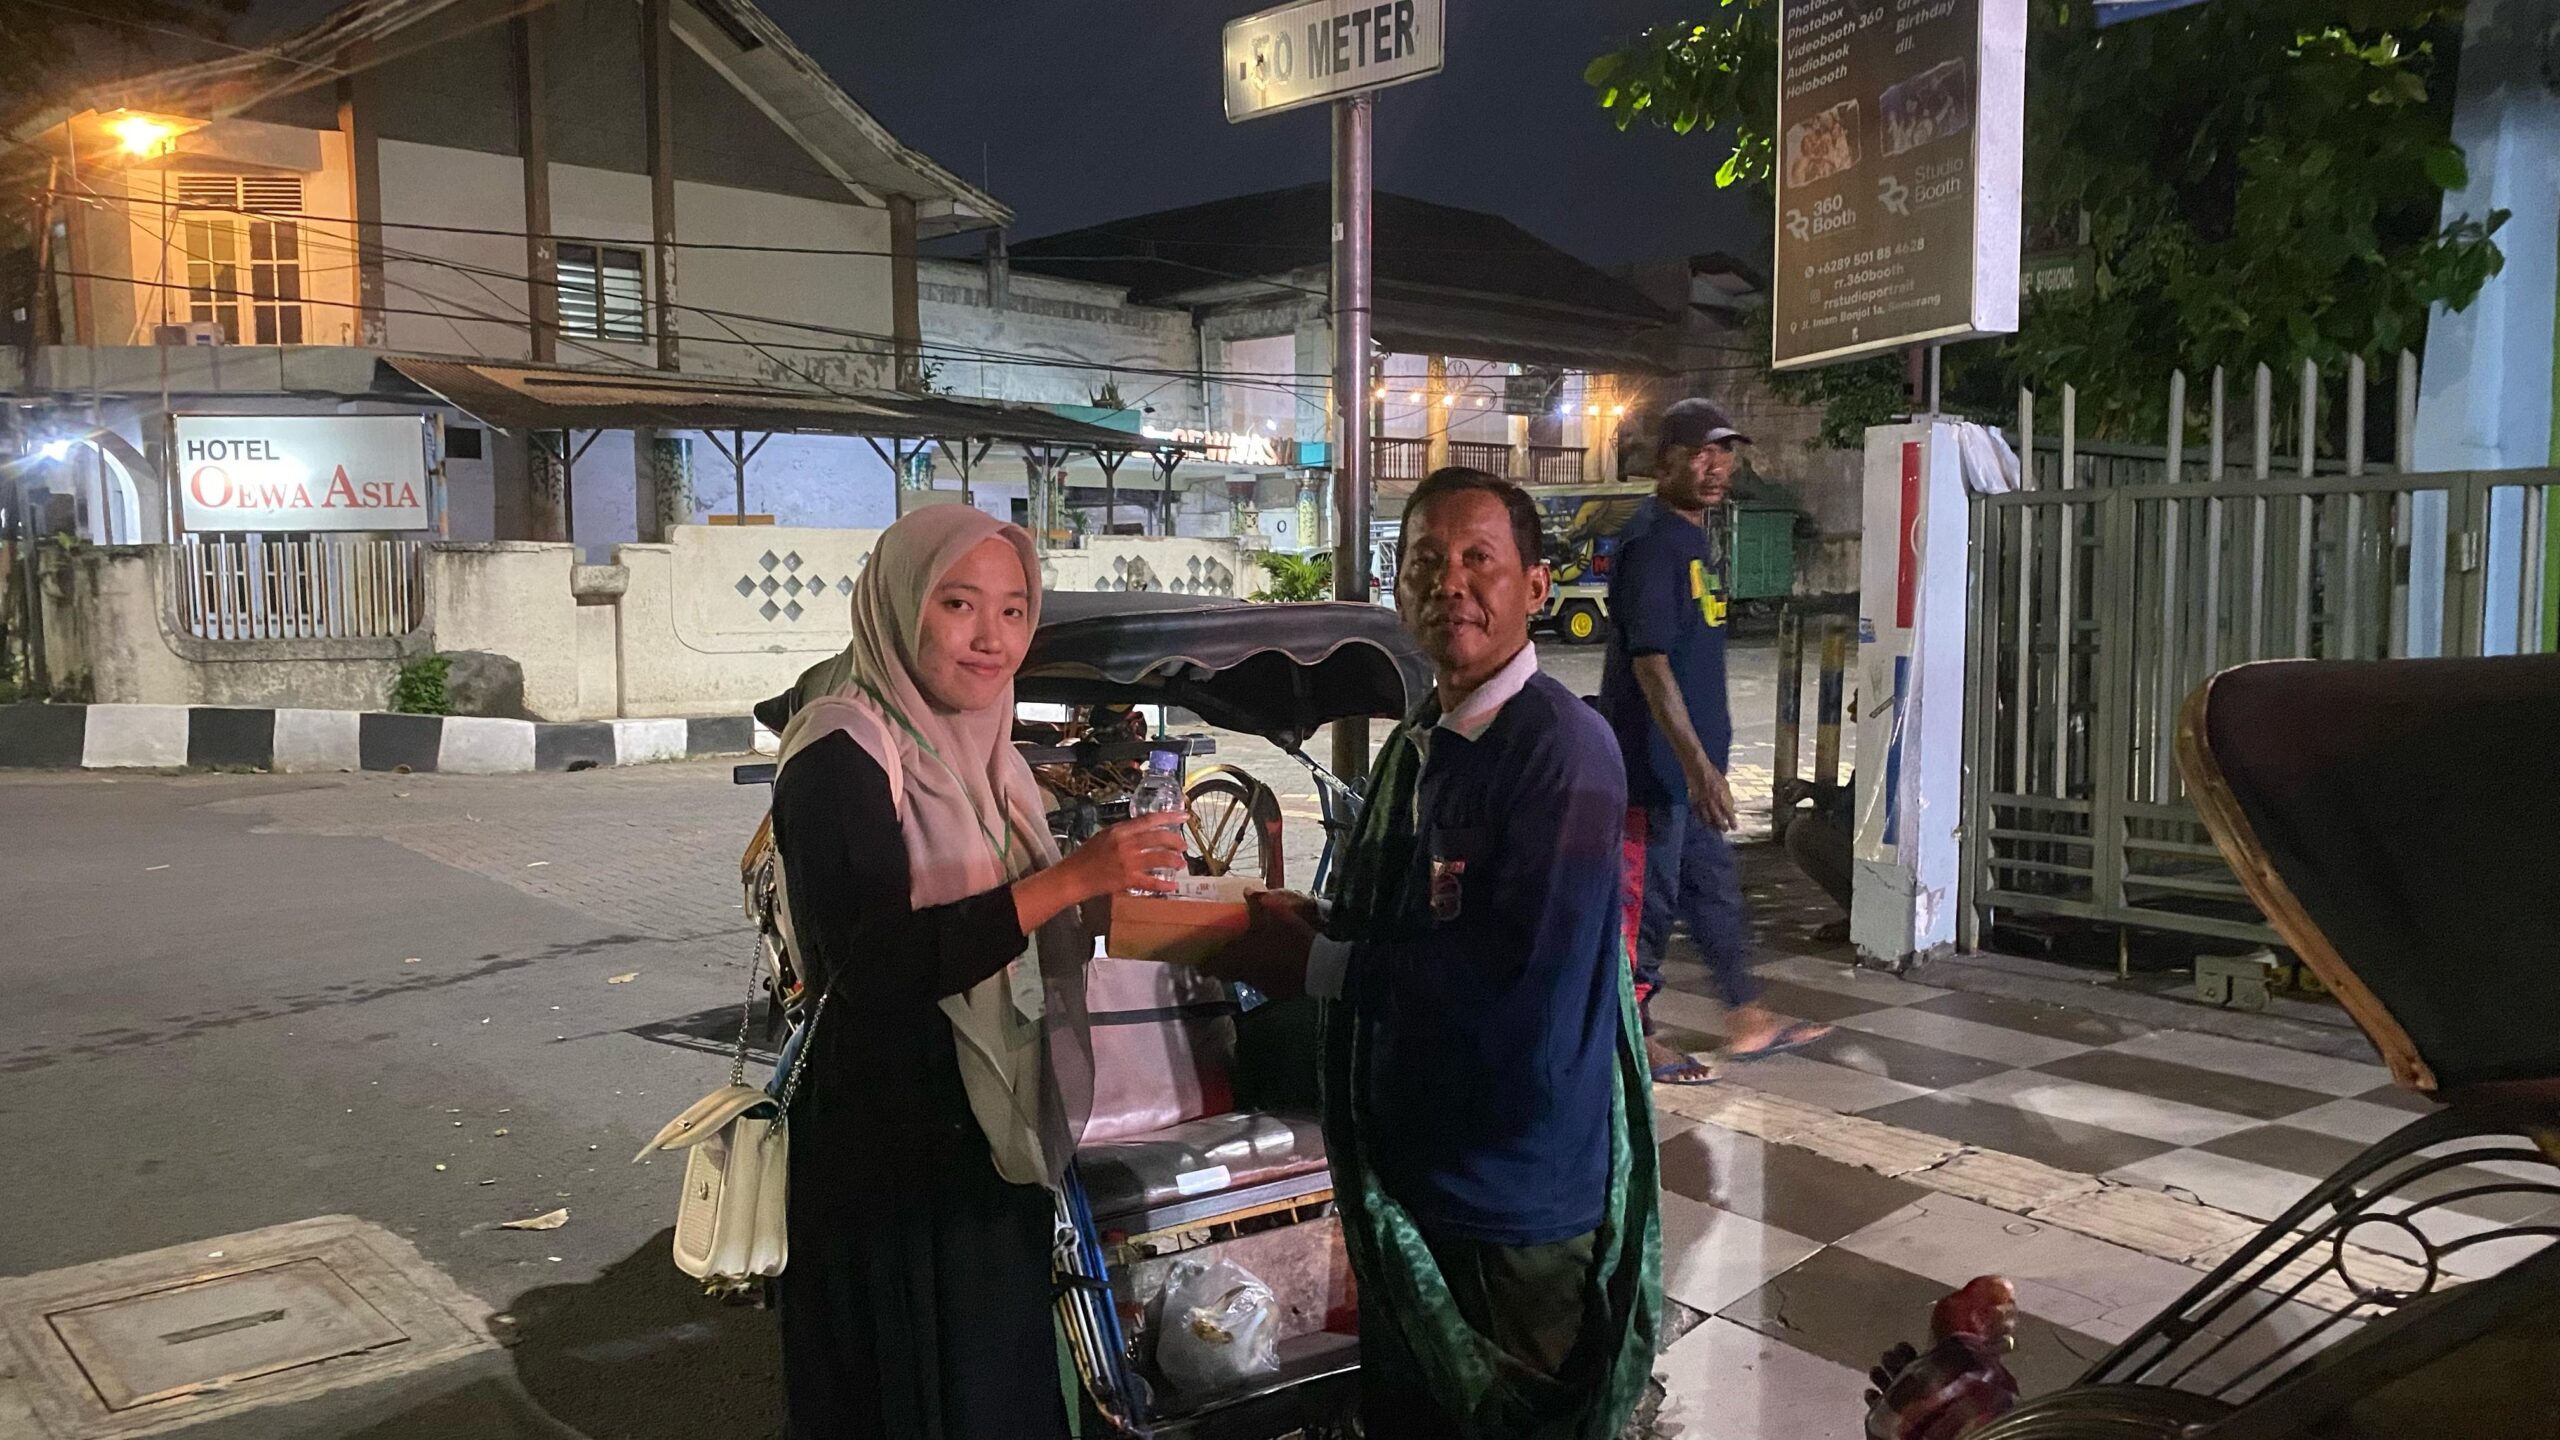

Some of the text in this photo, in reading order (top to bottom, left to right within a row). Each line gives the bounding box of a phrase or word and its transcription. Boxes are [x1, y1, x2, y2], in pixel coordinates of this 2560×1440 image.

[1787, 6, 1844, 41] Photobox
[1895, 0, 1955, 33] Birthday
[1308, 0, 1415, 80] METER
[1787, 7, 1884, 61] Videobooth 360
[1786, 44, 1850, 81] Audiobook
[1786, 64, 1847, 99] Holobooth
[1915, 158, 1964, 183] Studio
[1813, 194, 1843, 217] 360
[1915, 176, 1961, 203] Booth
[1813, 208, 1857, 235] Booth
[1834, 263, 1905, 290] rr.360booth
[187, 440, 280, 461] HOTEL
[321, 464, 420, 509] ASIA
